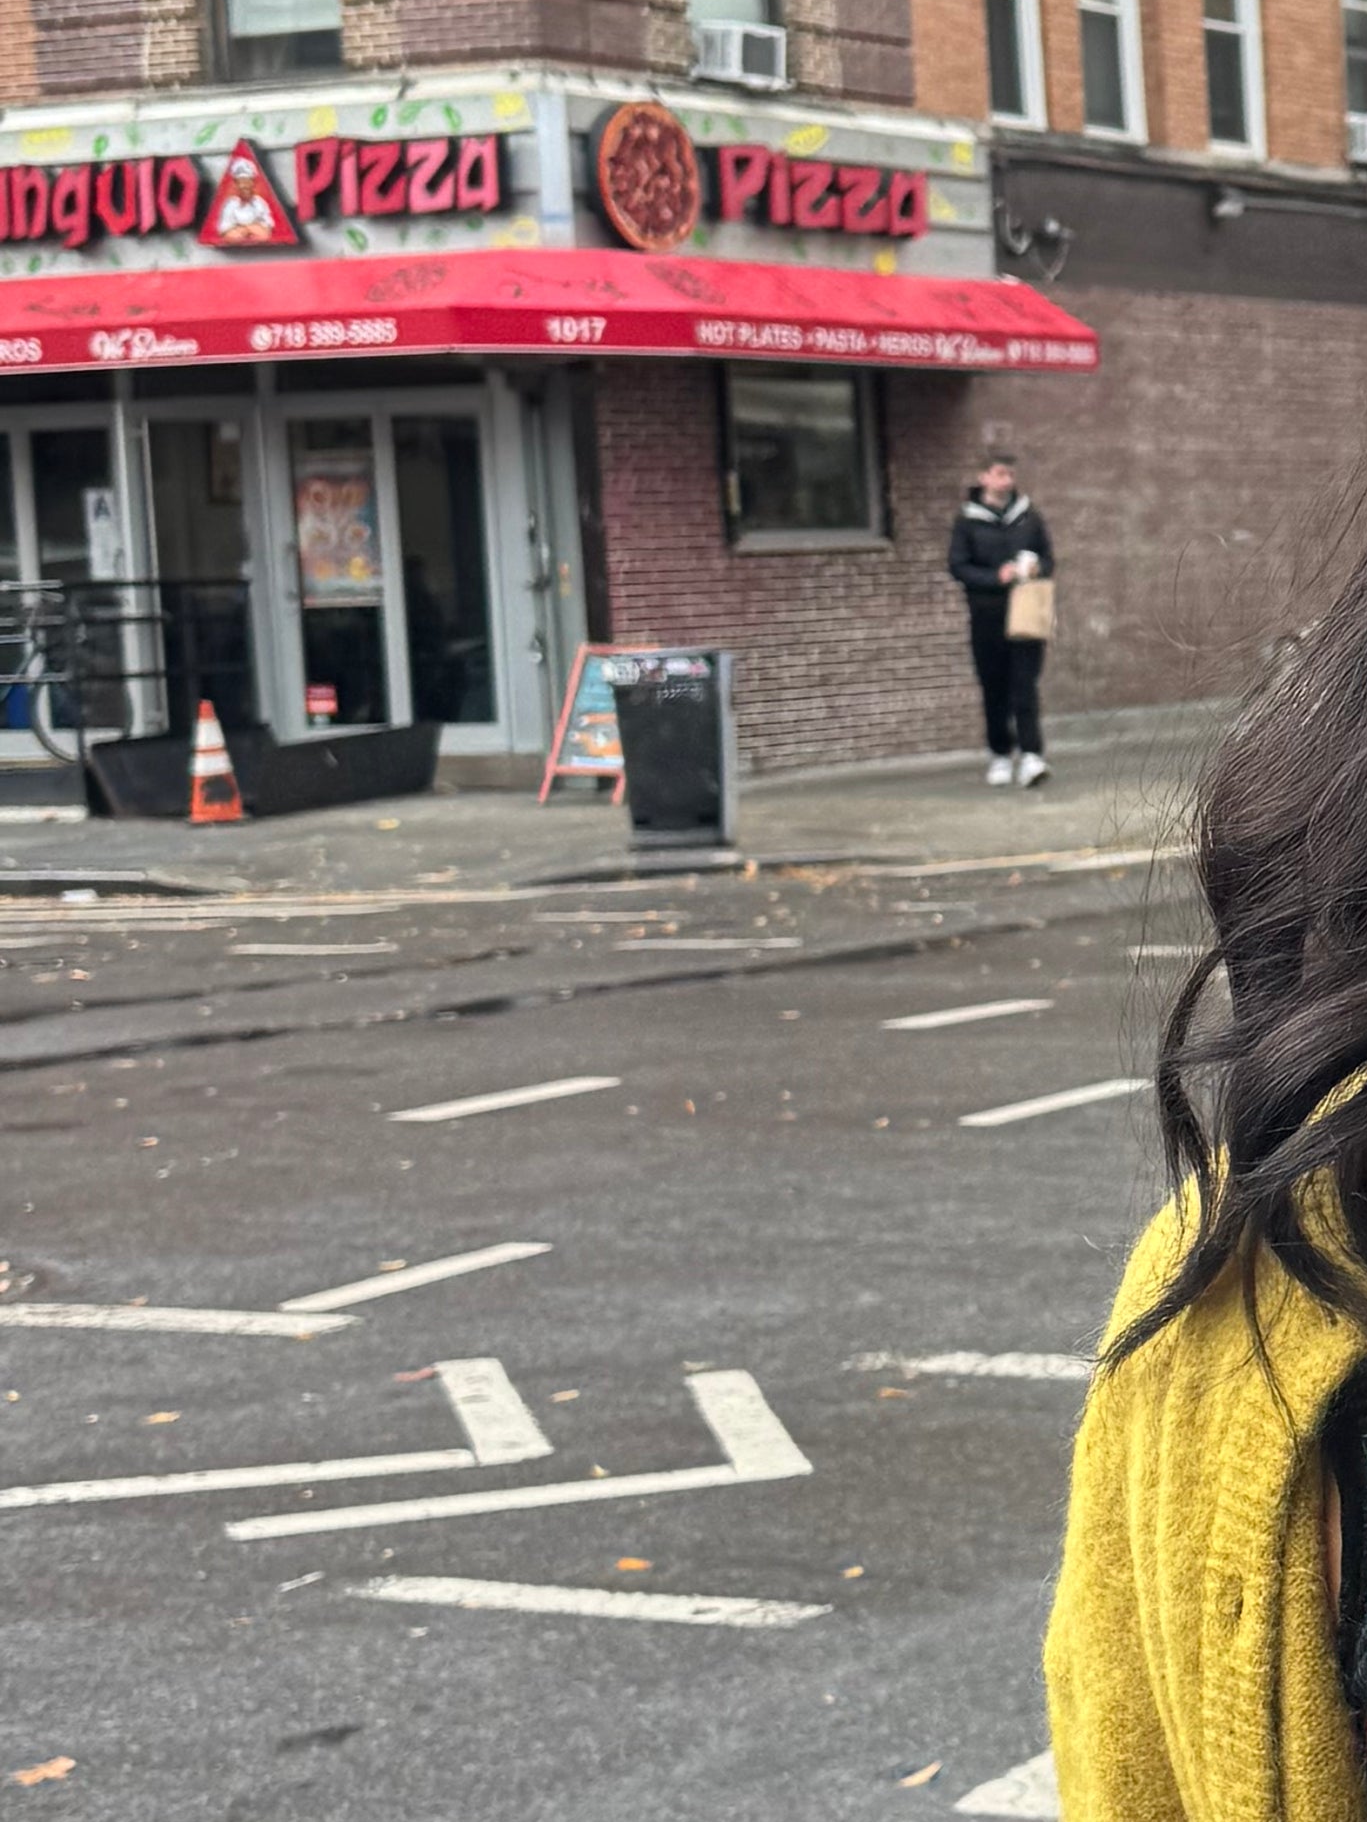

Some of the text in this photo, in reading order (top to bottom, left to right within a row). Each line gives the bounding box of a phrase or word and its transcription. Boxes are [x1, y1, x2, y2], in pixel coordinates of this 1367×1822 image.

[294, 133, 498, 222] Pizza
[719, 144, 928, 241] Pizza
[547, 315, 607, 344] 1017
